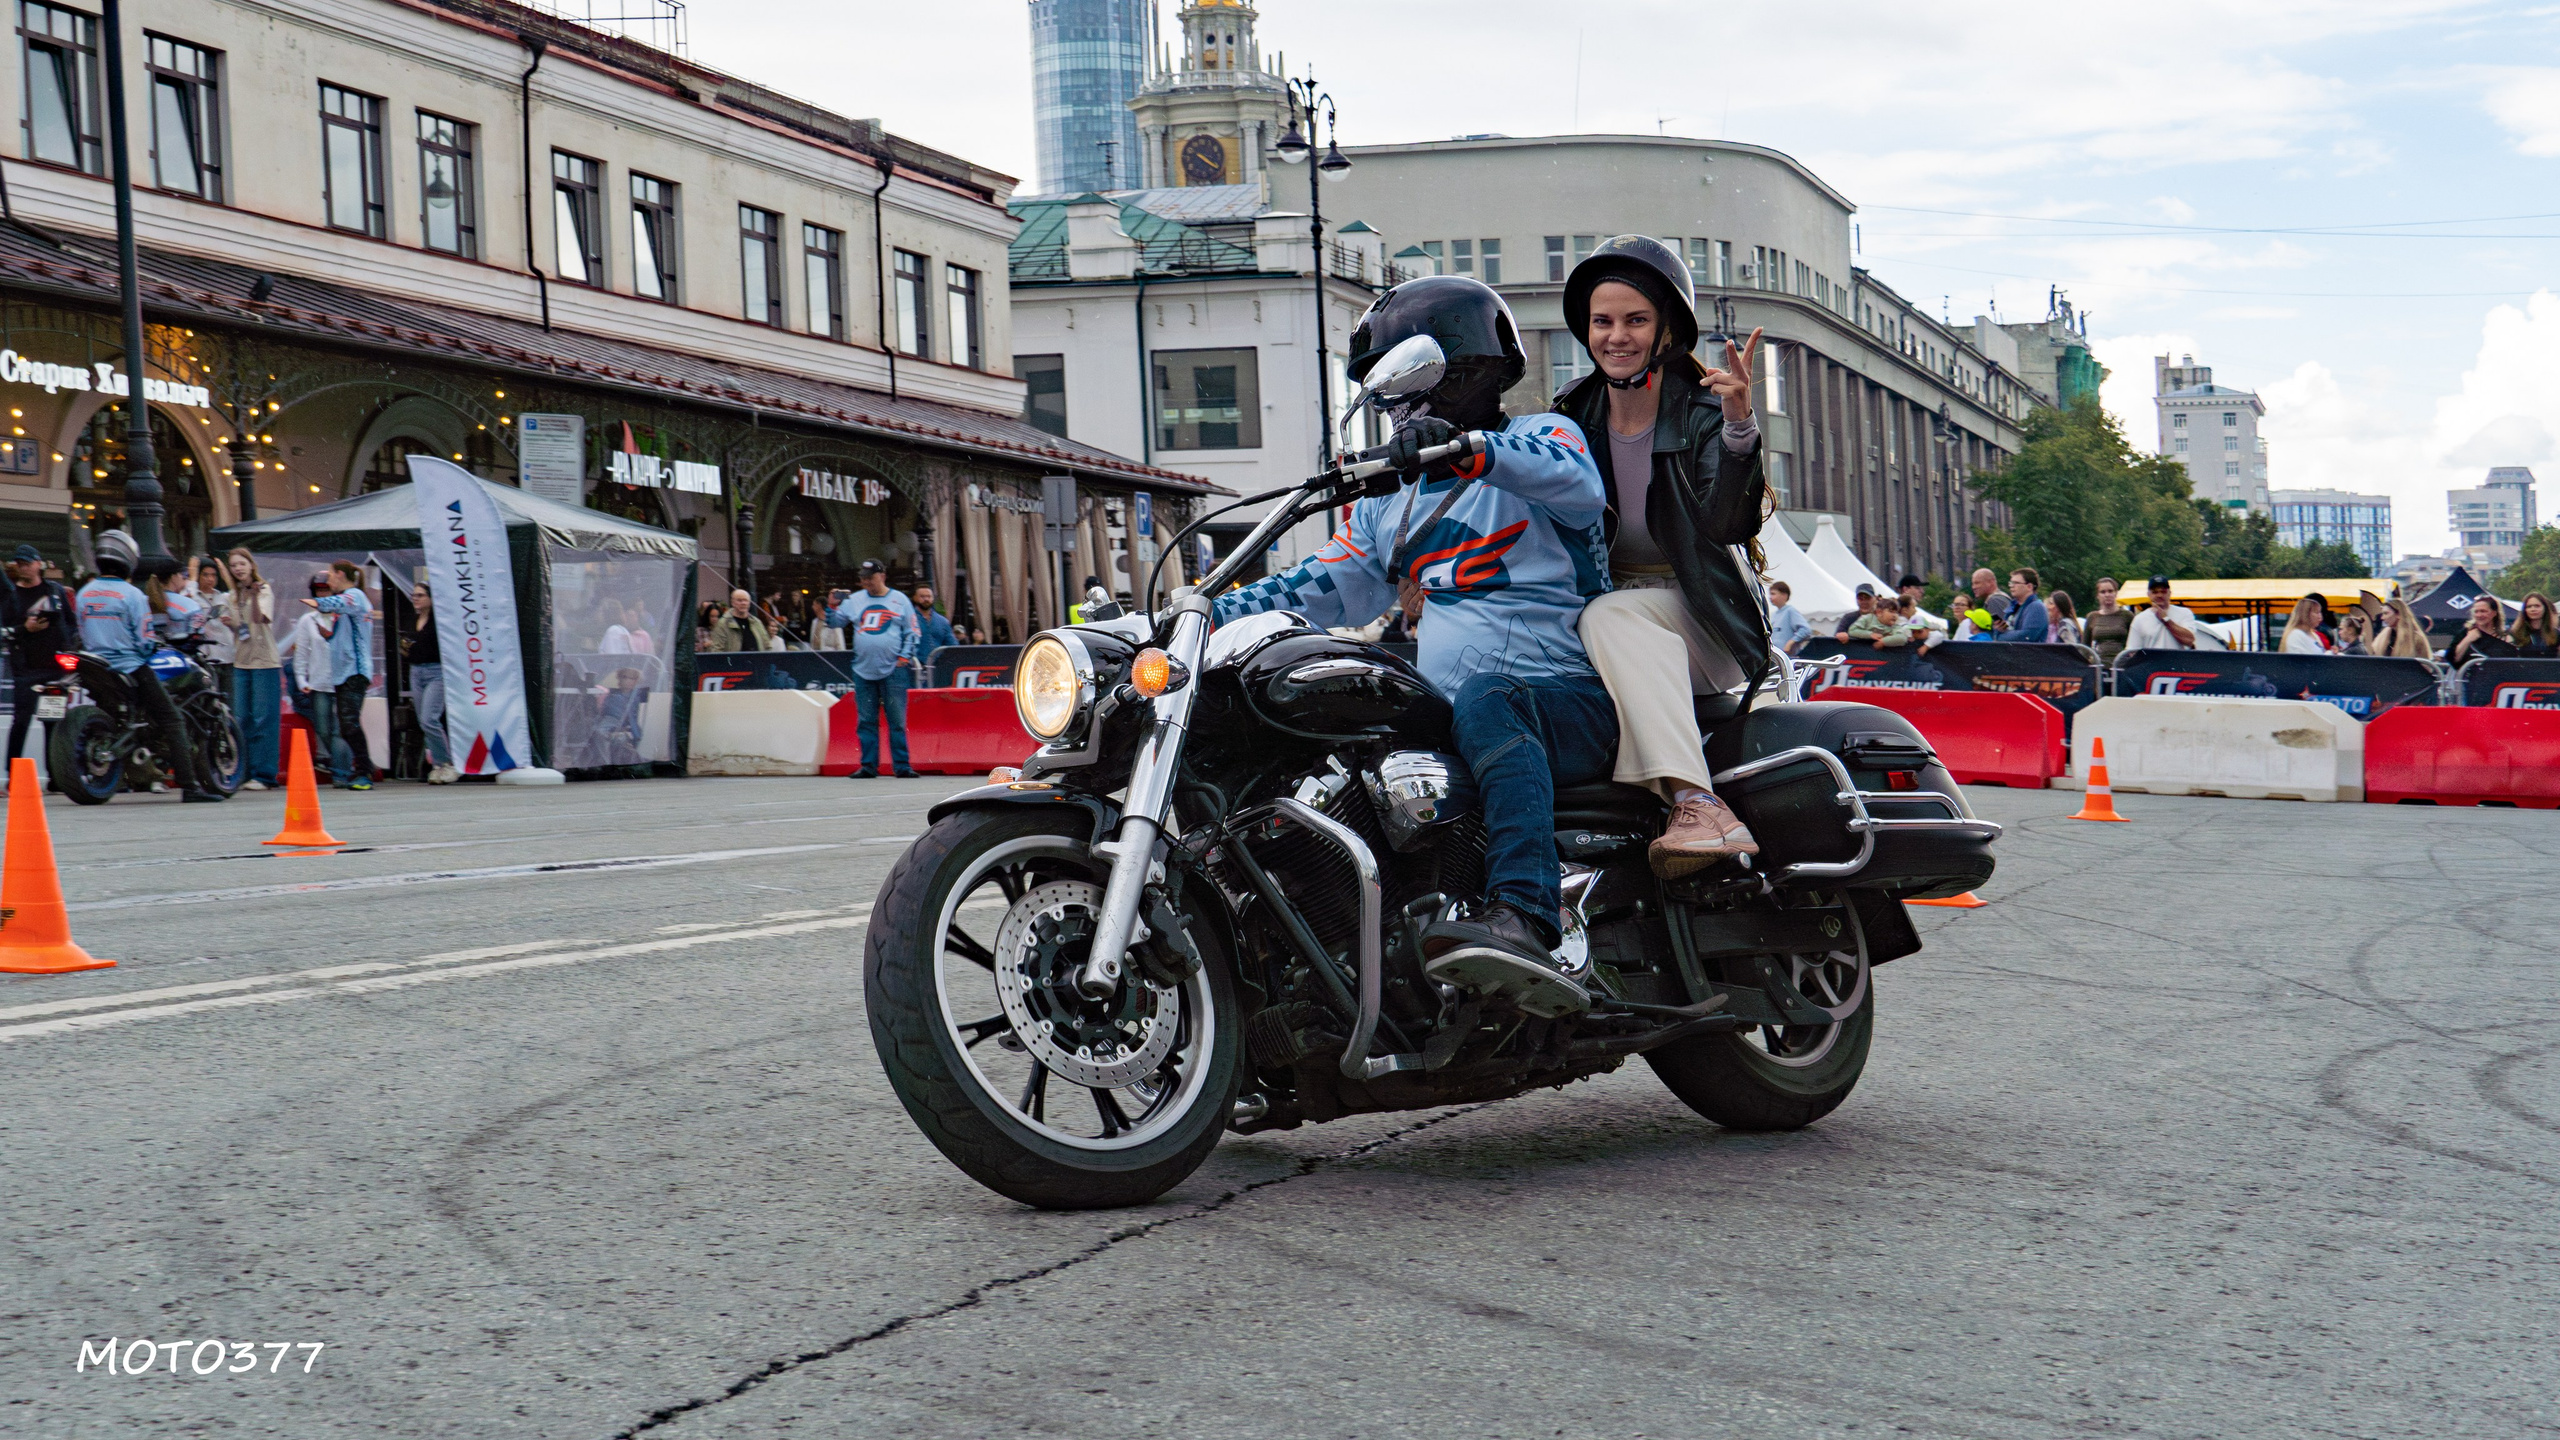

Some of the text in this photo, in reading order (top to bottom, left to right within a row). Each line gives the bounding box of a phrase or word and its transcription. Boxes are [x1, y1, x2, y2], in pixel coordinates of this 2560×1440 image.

[0, 350, 210, 408] Старик Хикалыч
[799, 468, 885, 506] ТАБАК 18+
[446, 499, 489, 706] MOTOGYMKHANA
